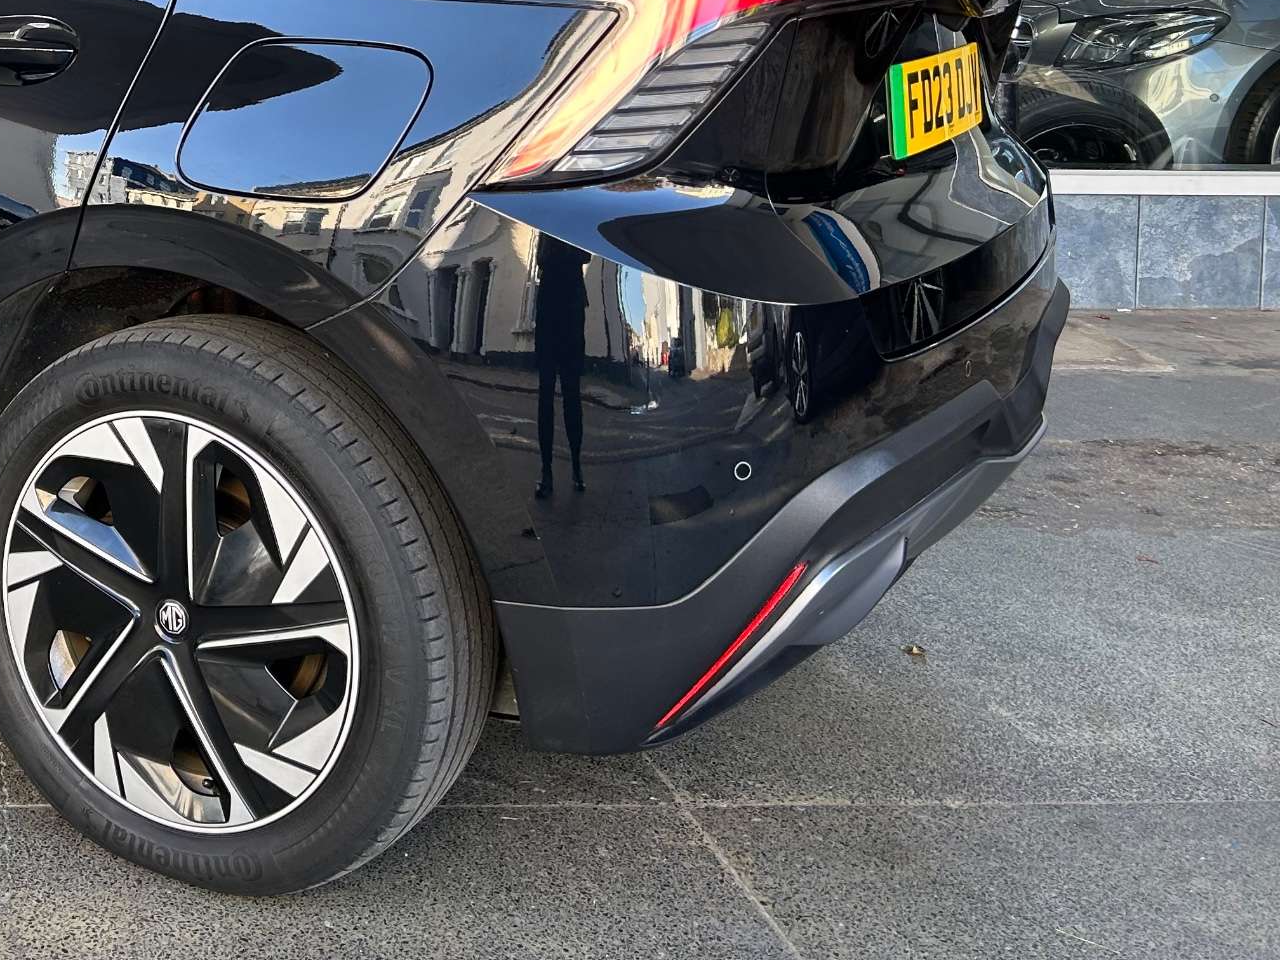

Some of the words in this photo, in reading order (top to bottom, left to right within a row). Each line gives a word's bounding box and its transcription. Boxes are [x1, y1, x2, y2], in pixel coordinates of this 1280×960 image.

[907, 62, 955, 139] FD23
[955, 52, 979, 120] DJY
[74, 368, 225, 413] Continental
[160, 603, 185, 633] MG
[100, 818, 264, 882] Continental
